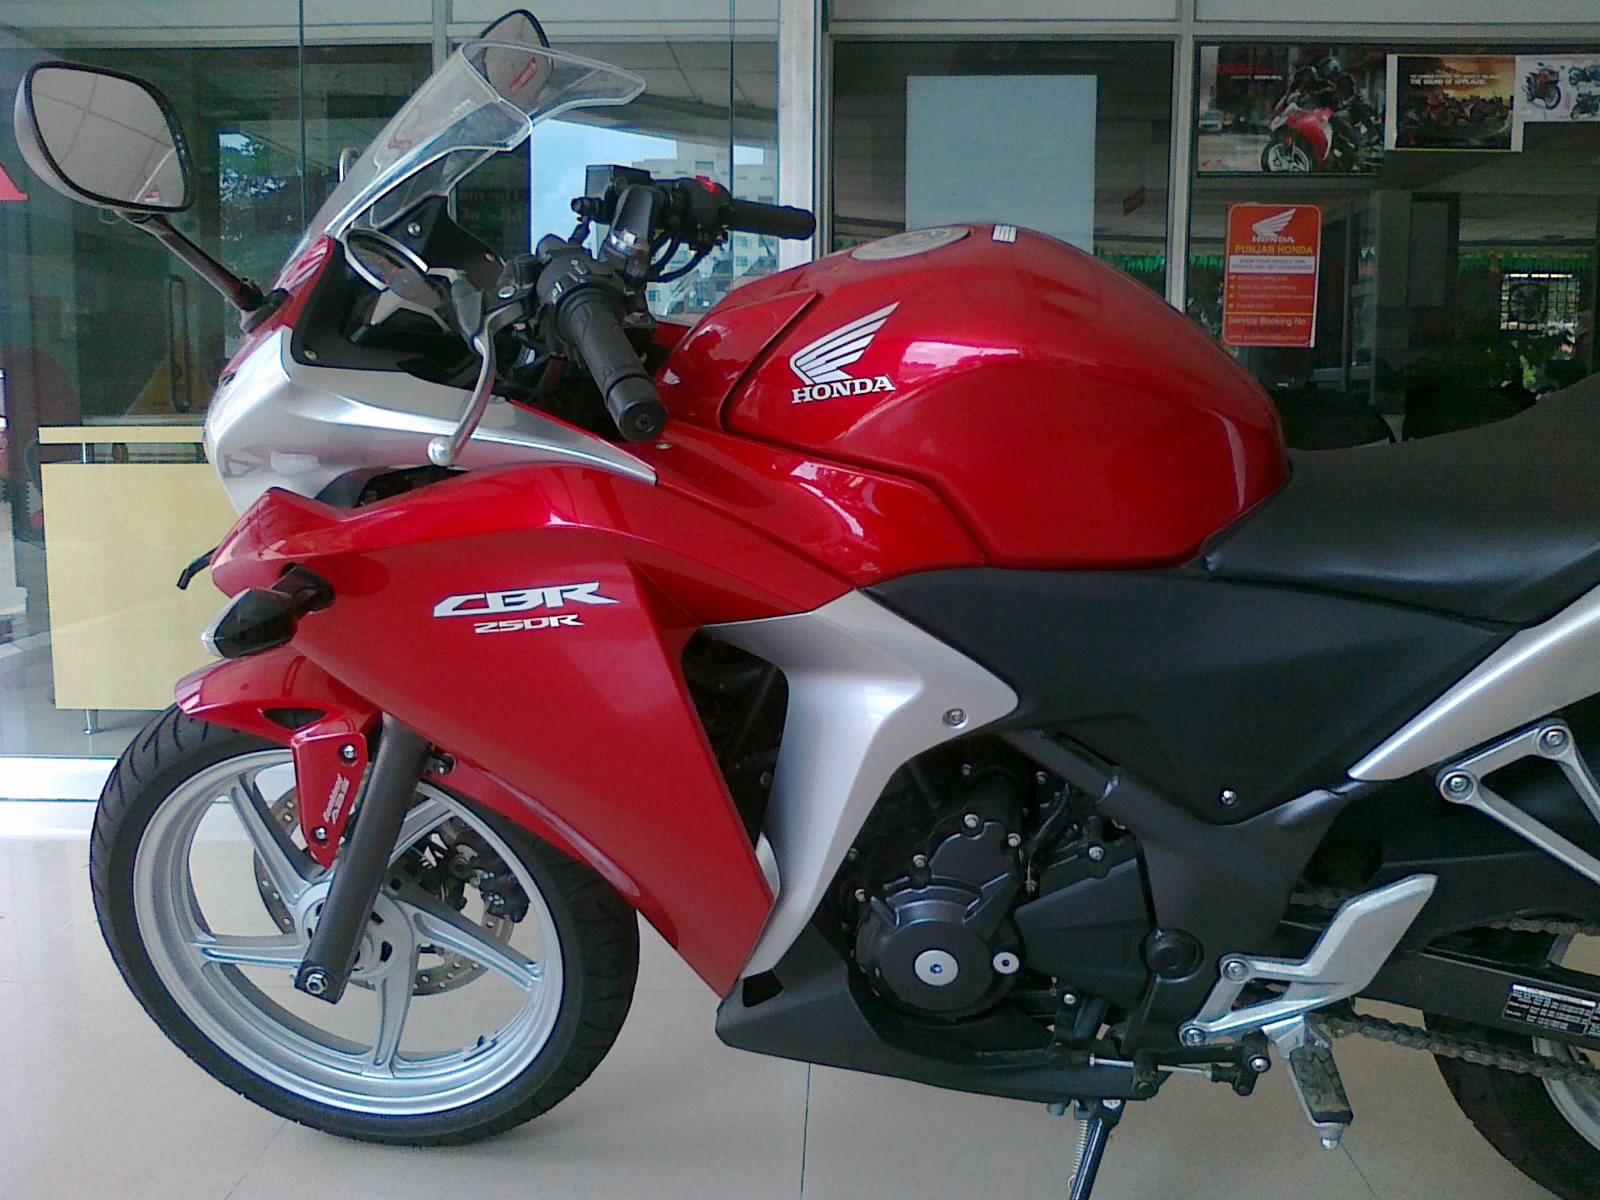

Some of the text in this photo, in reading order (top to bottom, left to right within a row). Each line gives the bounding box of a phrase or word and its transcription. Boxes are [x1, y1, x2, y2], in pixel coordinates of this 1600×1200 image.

[1234, 245, 1313, 254] PUNJAB HONDA
[790, 373, 897, 404] HONDA
[432, 581, 621, 618] CBR
[473, 613, 586, 635] 250R
